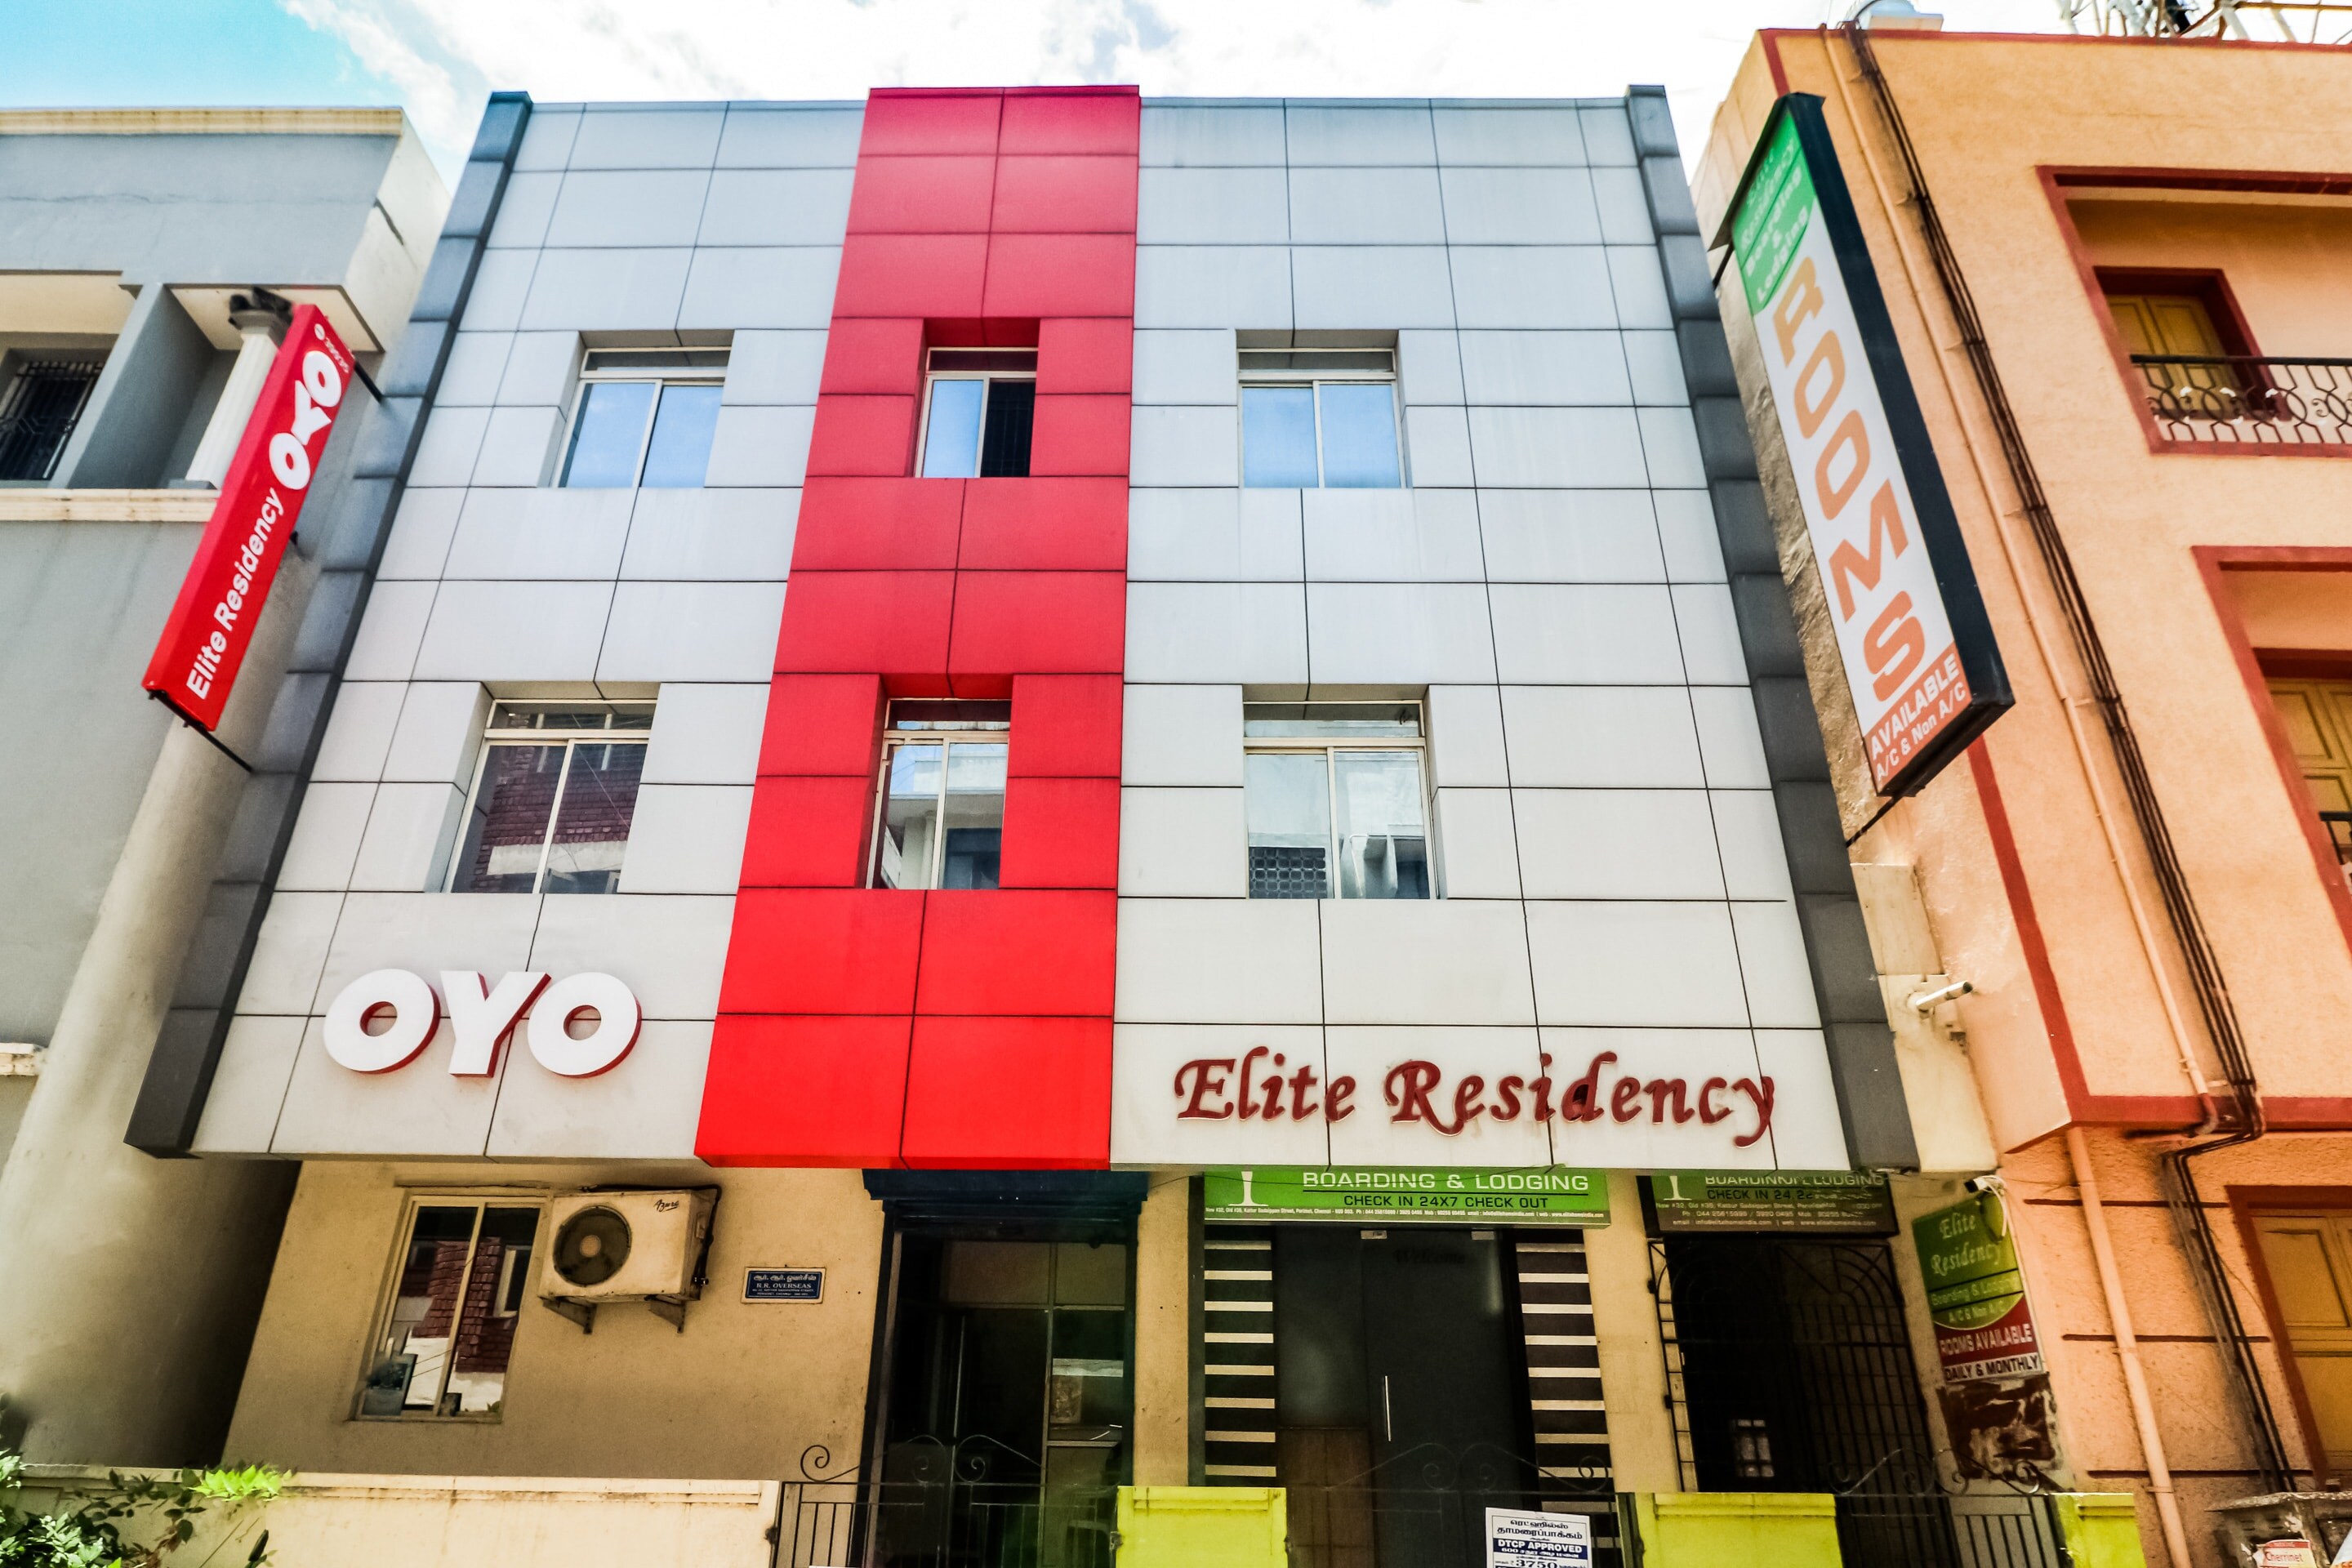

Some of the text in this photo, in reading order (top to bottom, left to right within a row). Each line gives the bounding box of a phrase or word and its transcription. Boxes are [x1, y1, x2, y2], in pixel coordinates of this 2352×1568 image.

[269, 350, 342, 490] OYO
[1772, 256, 1926, 702] ROOMS
[185, 487, 284, 700] Elite Residency
[1871, 653, 1960, 760] AVAILABLE
[1876, 682, 1966, 782] A/C & Non A/C
[323, 969, 643, 1079] OYO
[1174, 1045, 1776, 1150] Elite Residency
[1303, 1171, 1589, 1192] BOARDING & LODGING
[1707, 1189, 1750, 1200] CHECK
[1755, 1189, 1769, 1200] IN
[1343, 1195, 1548, 1209] CHECK IN 24X7 CHECK OUT
[1940, 1212, 1976, 1239] Elite
[1930, 1242, 2000, 1276] Residency
[1940, 1323, 2033, 1356] ROOMS AVAILABLE
[1945, 1355, 2038, 1381] DAILY & MONTHLY
[1498, 1539, 1526, 1548] DTCP
[1527, 1542, 1583, 1553] APPROVED
[1516, 1559, 1558, 1568] 3750
